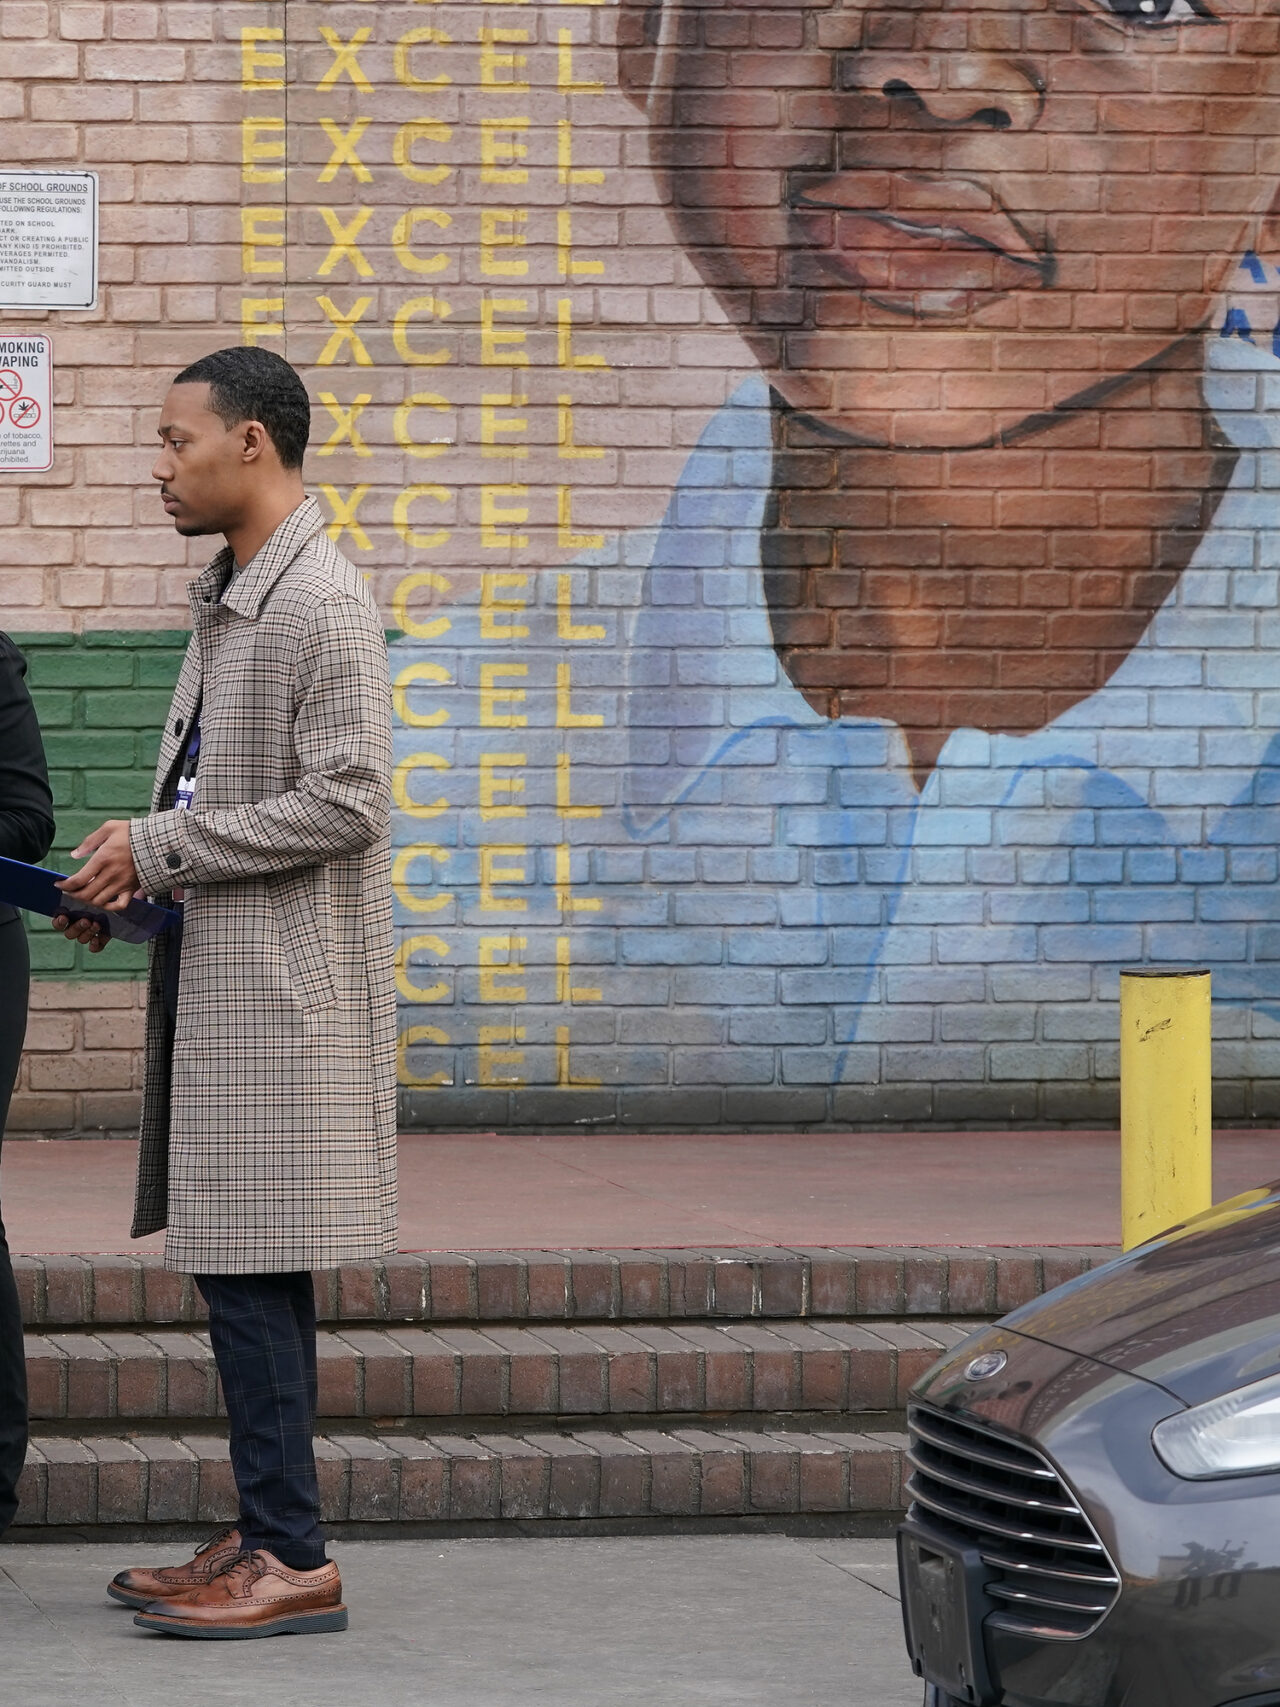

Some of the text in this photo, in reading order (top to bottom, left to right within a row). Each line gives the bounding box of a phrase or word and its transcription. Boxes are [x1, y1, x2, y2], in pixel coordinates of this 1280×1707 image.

[240, 27, 605, 94] EXCEL
[241, 116, 606, 185] EXCEL
[9, 183, 44, 191] SCHOOL
[46, 183, 88, 192] GROUNDS
[240, 207, 605, 277] EXCEL
[317, 391, 606, 459] XCEL
[322, 482, 606, 550] XCEL
